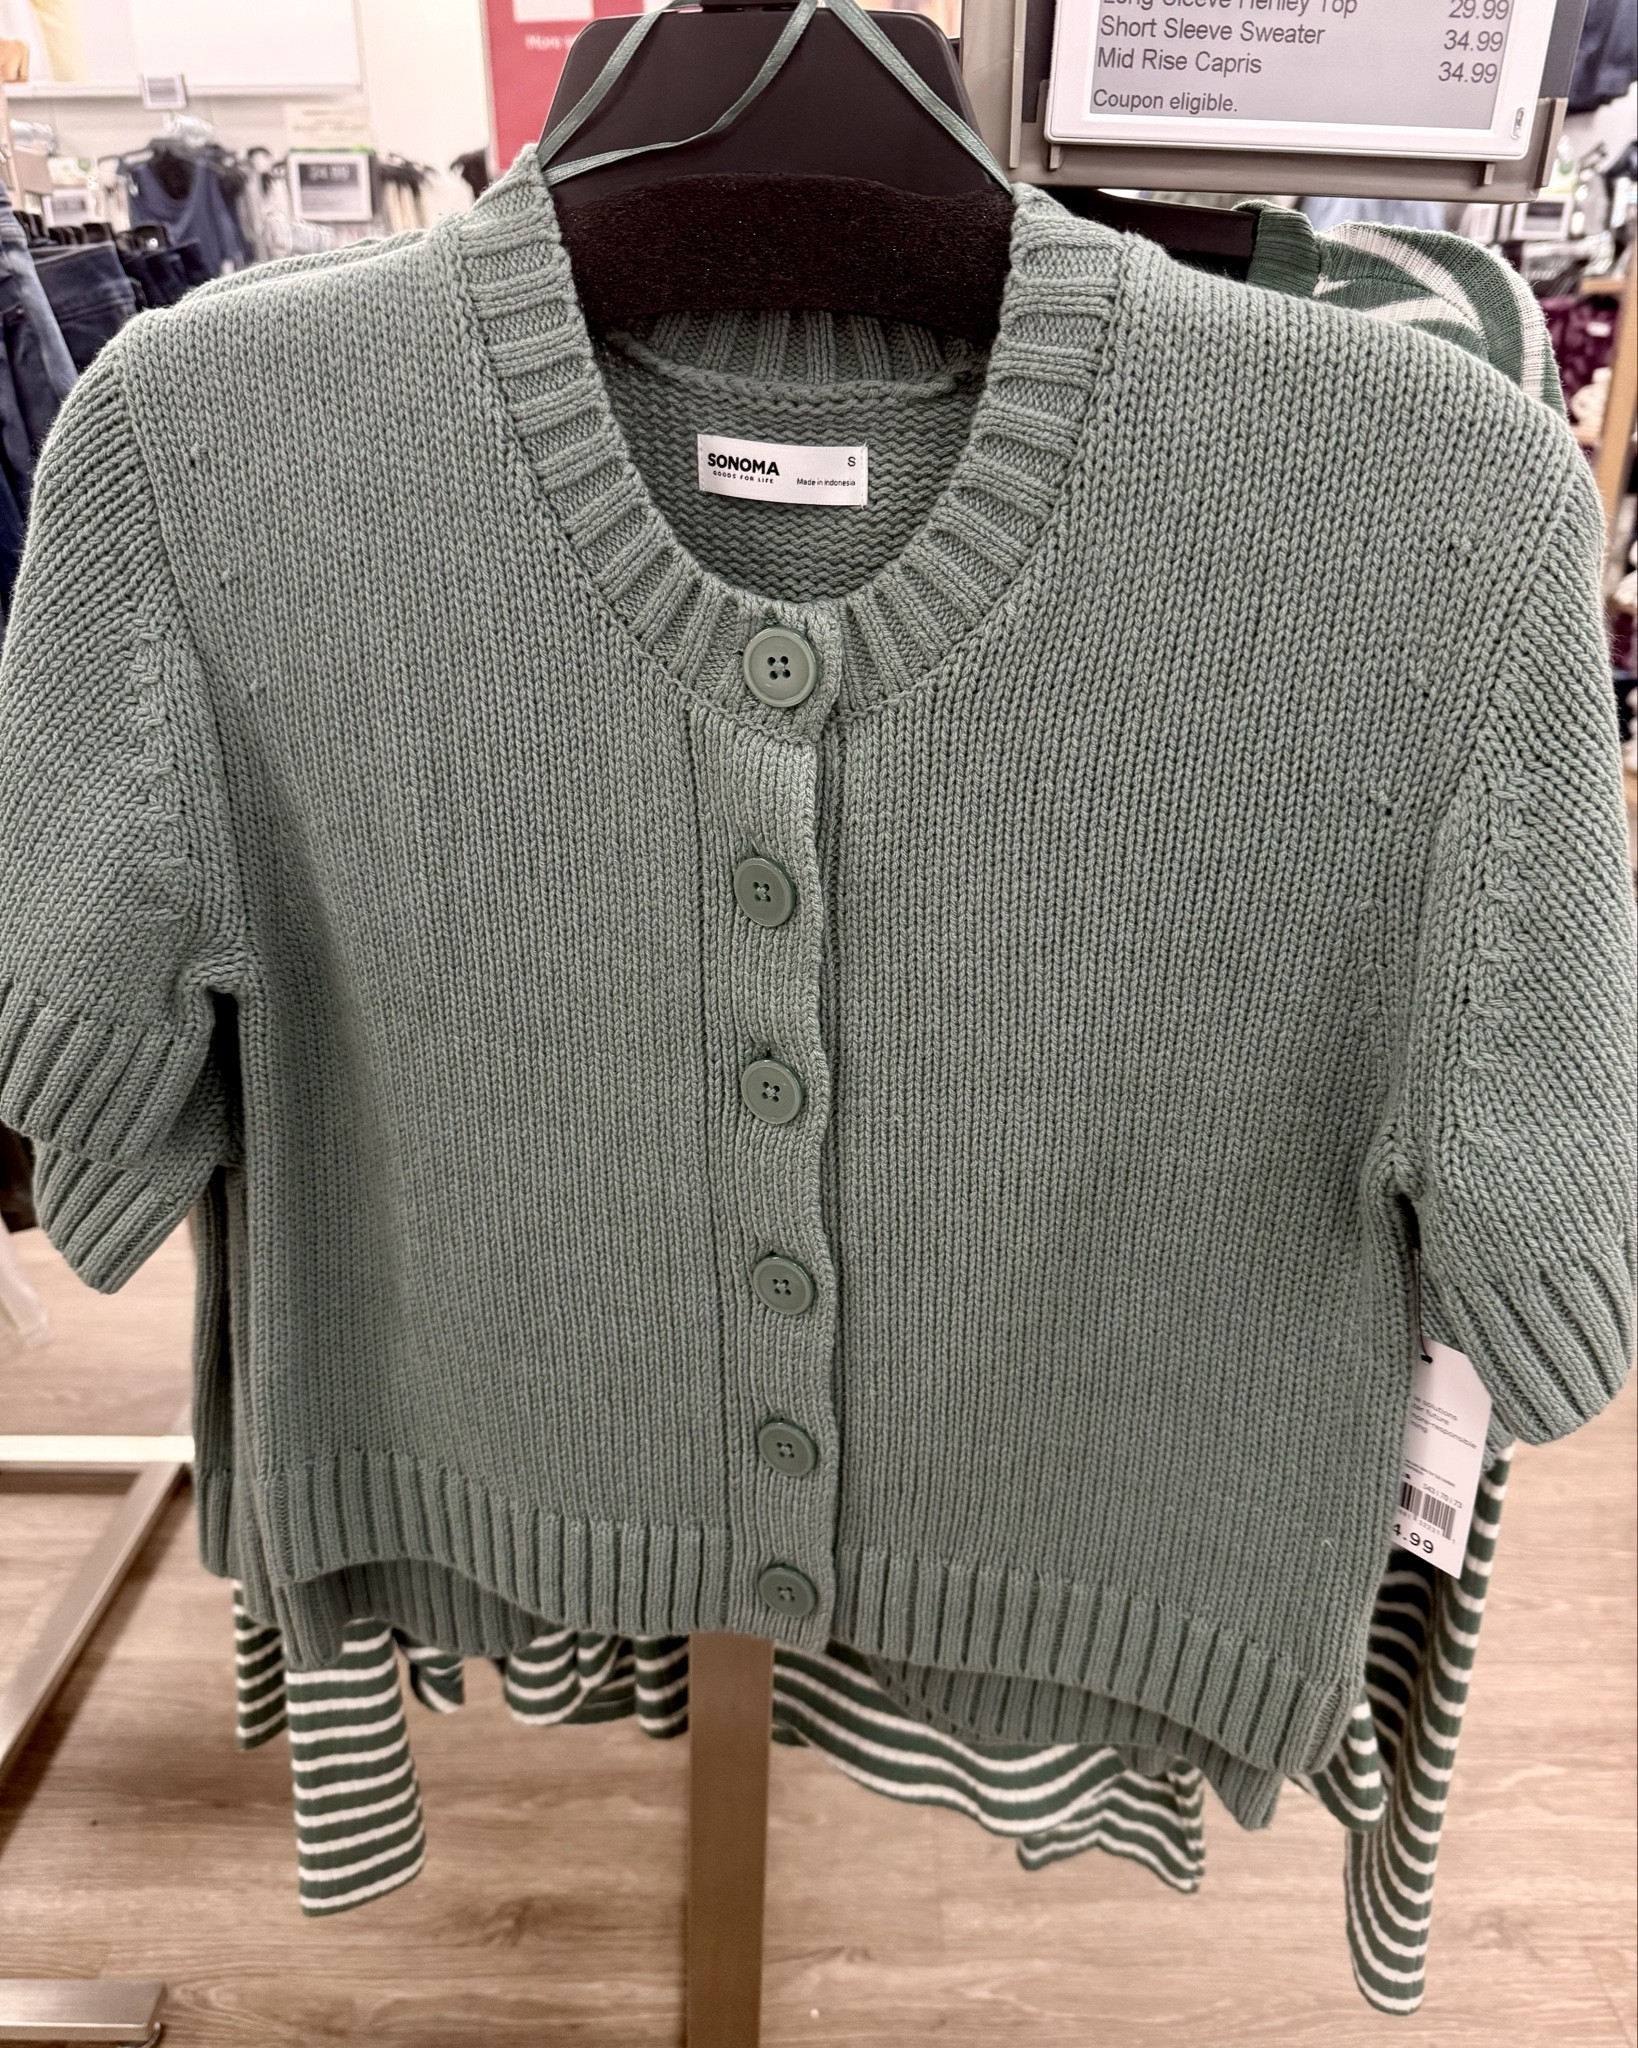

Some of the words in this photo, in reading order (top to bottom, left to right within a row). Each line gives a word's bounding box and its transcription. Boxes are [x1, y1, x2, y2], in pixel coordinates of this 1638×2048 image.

[1163, 0, 1231, 9] eeve
[1448, 0, 1510, 20] 29.99
[1100, 14, 1157, 38] Short
[1163, 17, 1233, 40] Sleeve
[1240, 20, 1326, 44] Sweater
[1443, 29, 1504, 52] 34.99
[1097, 46, 1135, 69] Mid
[1142, 48, 1188, 71] Rise
[1195, 51, 1262, 78] Capris
[1438, 61, 1498, 84] 34.99
[1093, 89, 1164, 112] Coupon
[1169, 92, 1238, 115] eligible.
[707, 453, 780, 476] SONOMA
[847, 456, 856, 467] S
[713, 470, 737, 479] GOODS
[740, 474, 754, 482] FOR
[797, 478, 816, 486] Made
[824, 478, 856, 486] Indonesia
[1423, 1400, 1458, 1421] solutions
[1426, 1409, 1450, 1425] future
